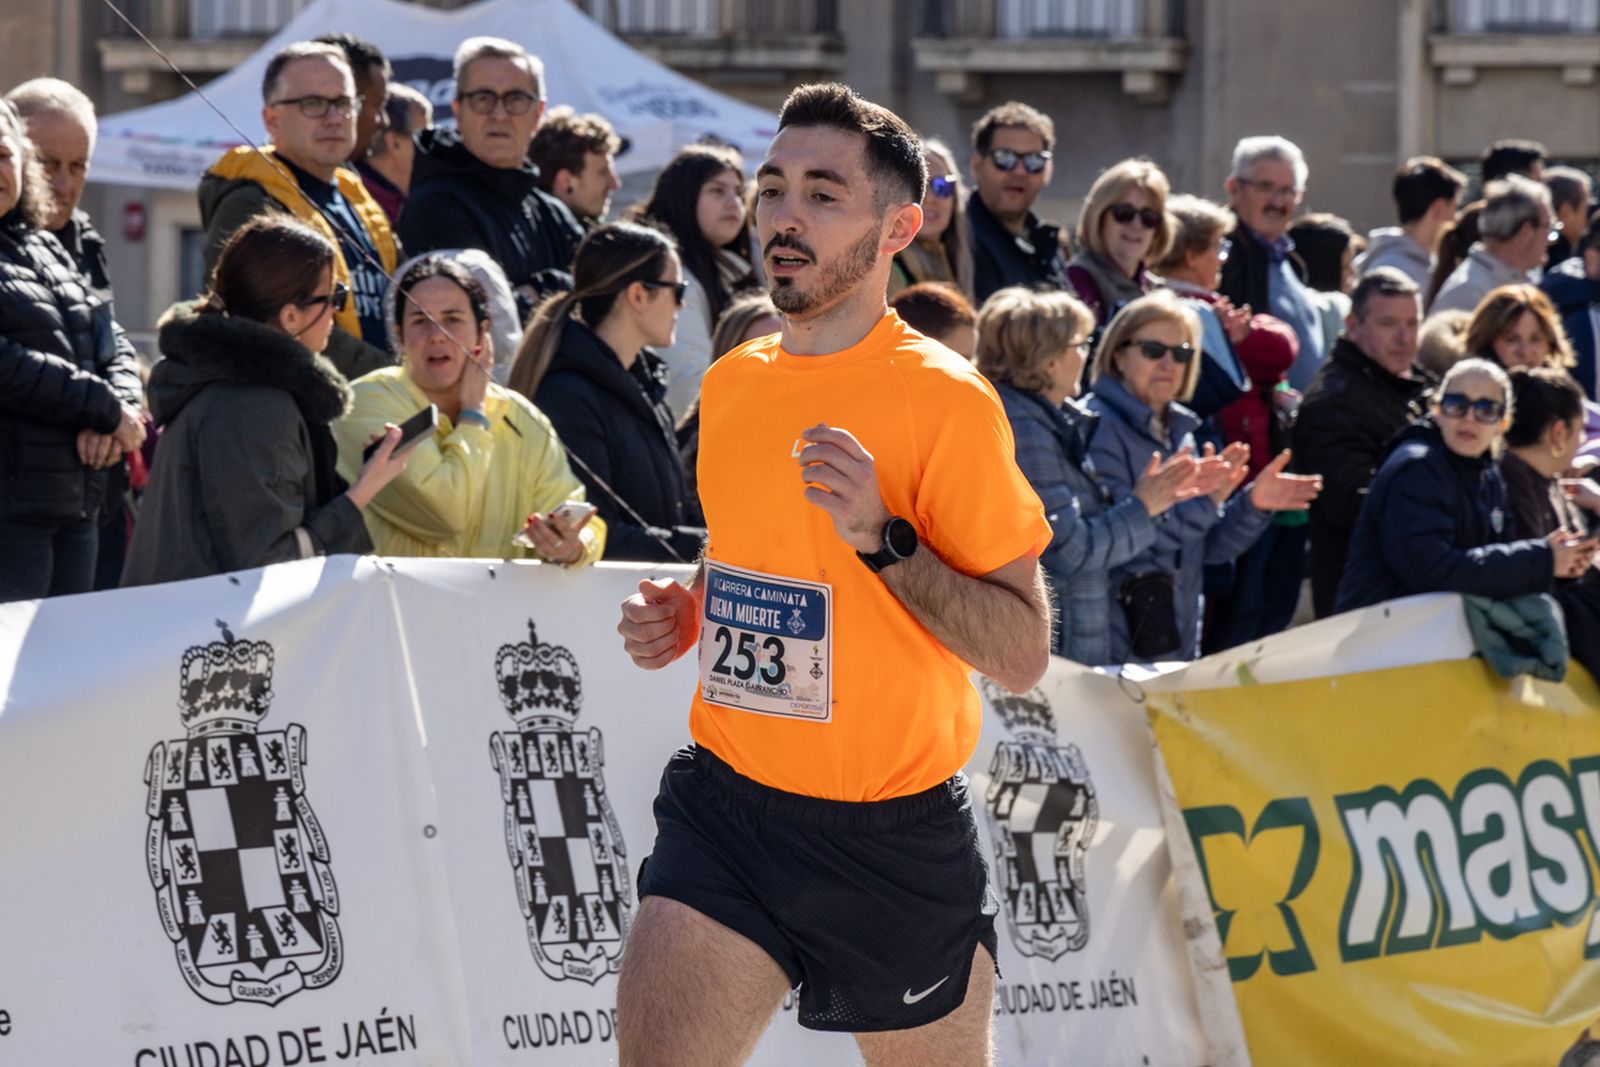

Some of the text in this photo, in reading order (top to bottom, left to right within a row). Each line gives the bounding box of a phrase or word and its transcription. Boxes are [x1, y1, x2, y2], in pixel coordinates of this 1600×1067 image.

[719, 579, 752, 598] CARRERA
[754, 587, 808, 607] CAMINATA
[736, 603, 781, 629] MUERTE
[712, 626, 786, 686] 253
[709, 674, 726, 685] DANIEL
[727, 679, 744, 688] PLAZA
[321, 870, 334, 893] LOS
[237, 984, 277, 998] GUARDA
[1058, 981, 1084, 1011] DE
[1089, 970, 1138, 1009] JAÉN
[135, 1007, 417, 1067] CIUDAD DE JAÉN
[503, 1010, 593, 1050] CIUDAD
